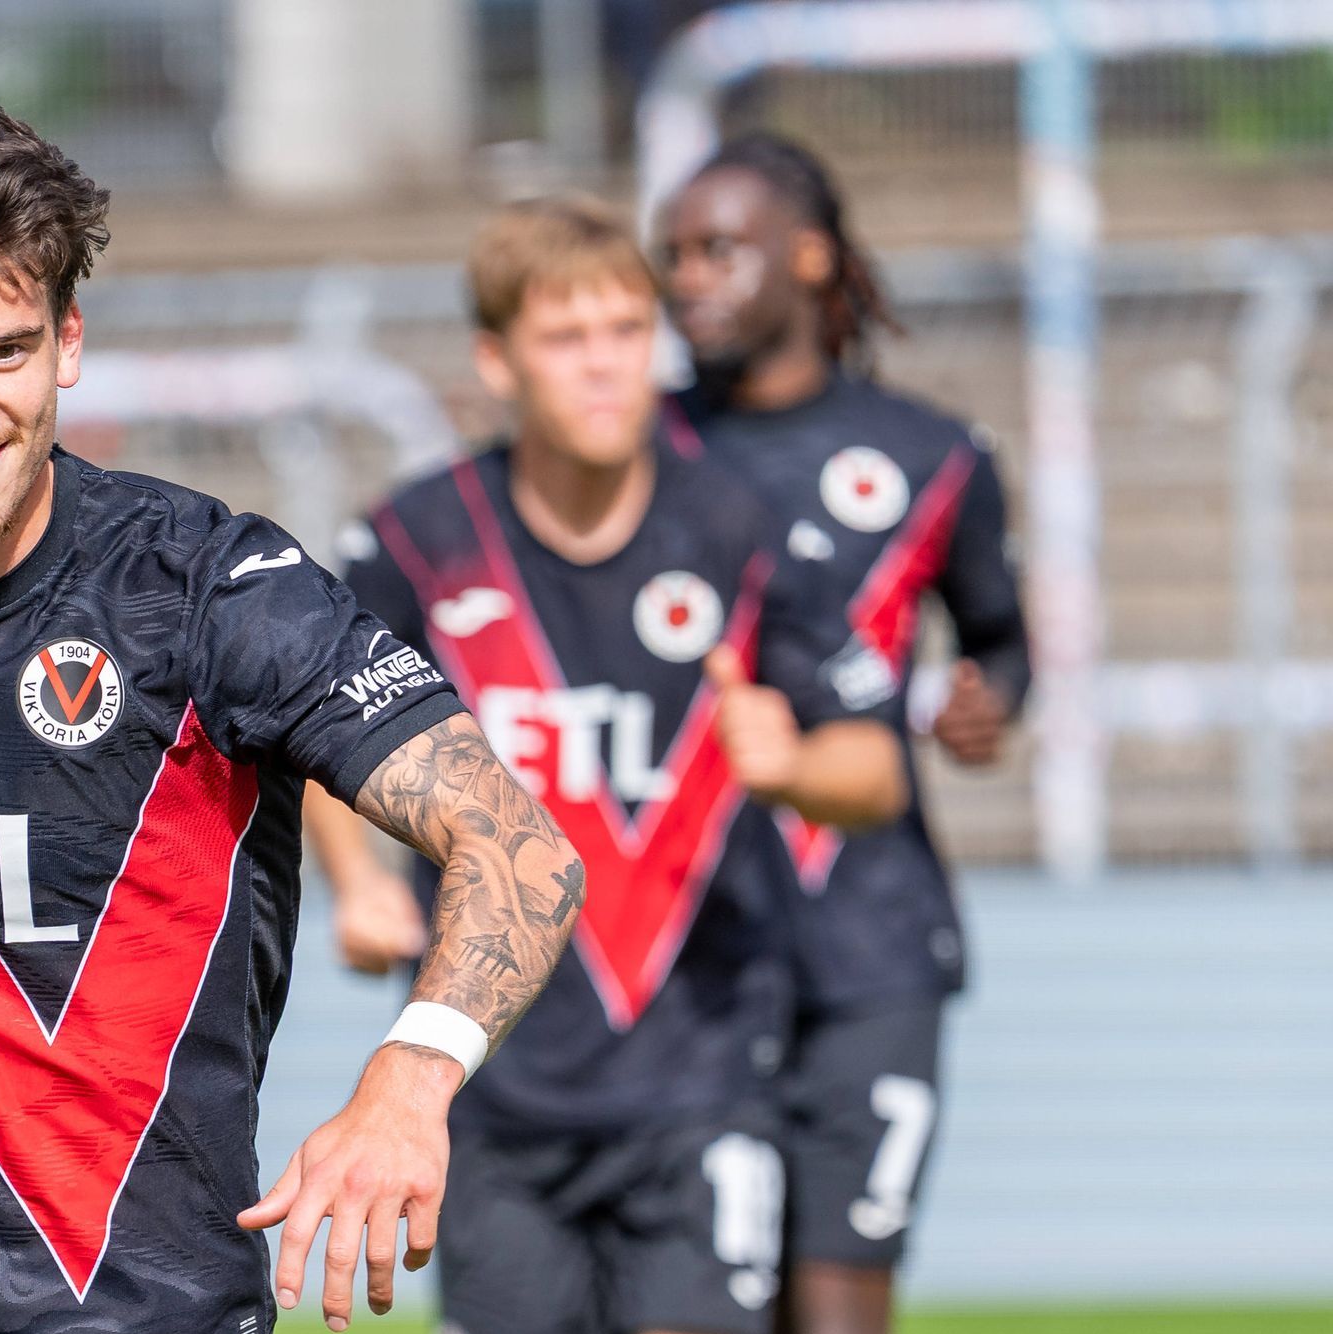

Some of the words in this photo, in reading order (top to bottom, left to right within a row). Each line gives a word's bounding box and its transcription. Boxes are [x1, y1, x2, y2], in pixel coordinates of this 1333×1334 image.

[59, 645, 90, 659] 1904
[24, 681, 87, 742] VIKTORIA
[94, 685, 118, 731] KÖLN
[477, 683, 677, 804] ETL
[866, 1074, 935, 1200] 7
